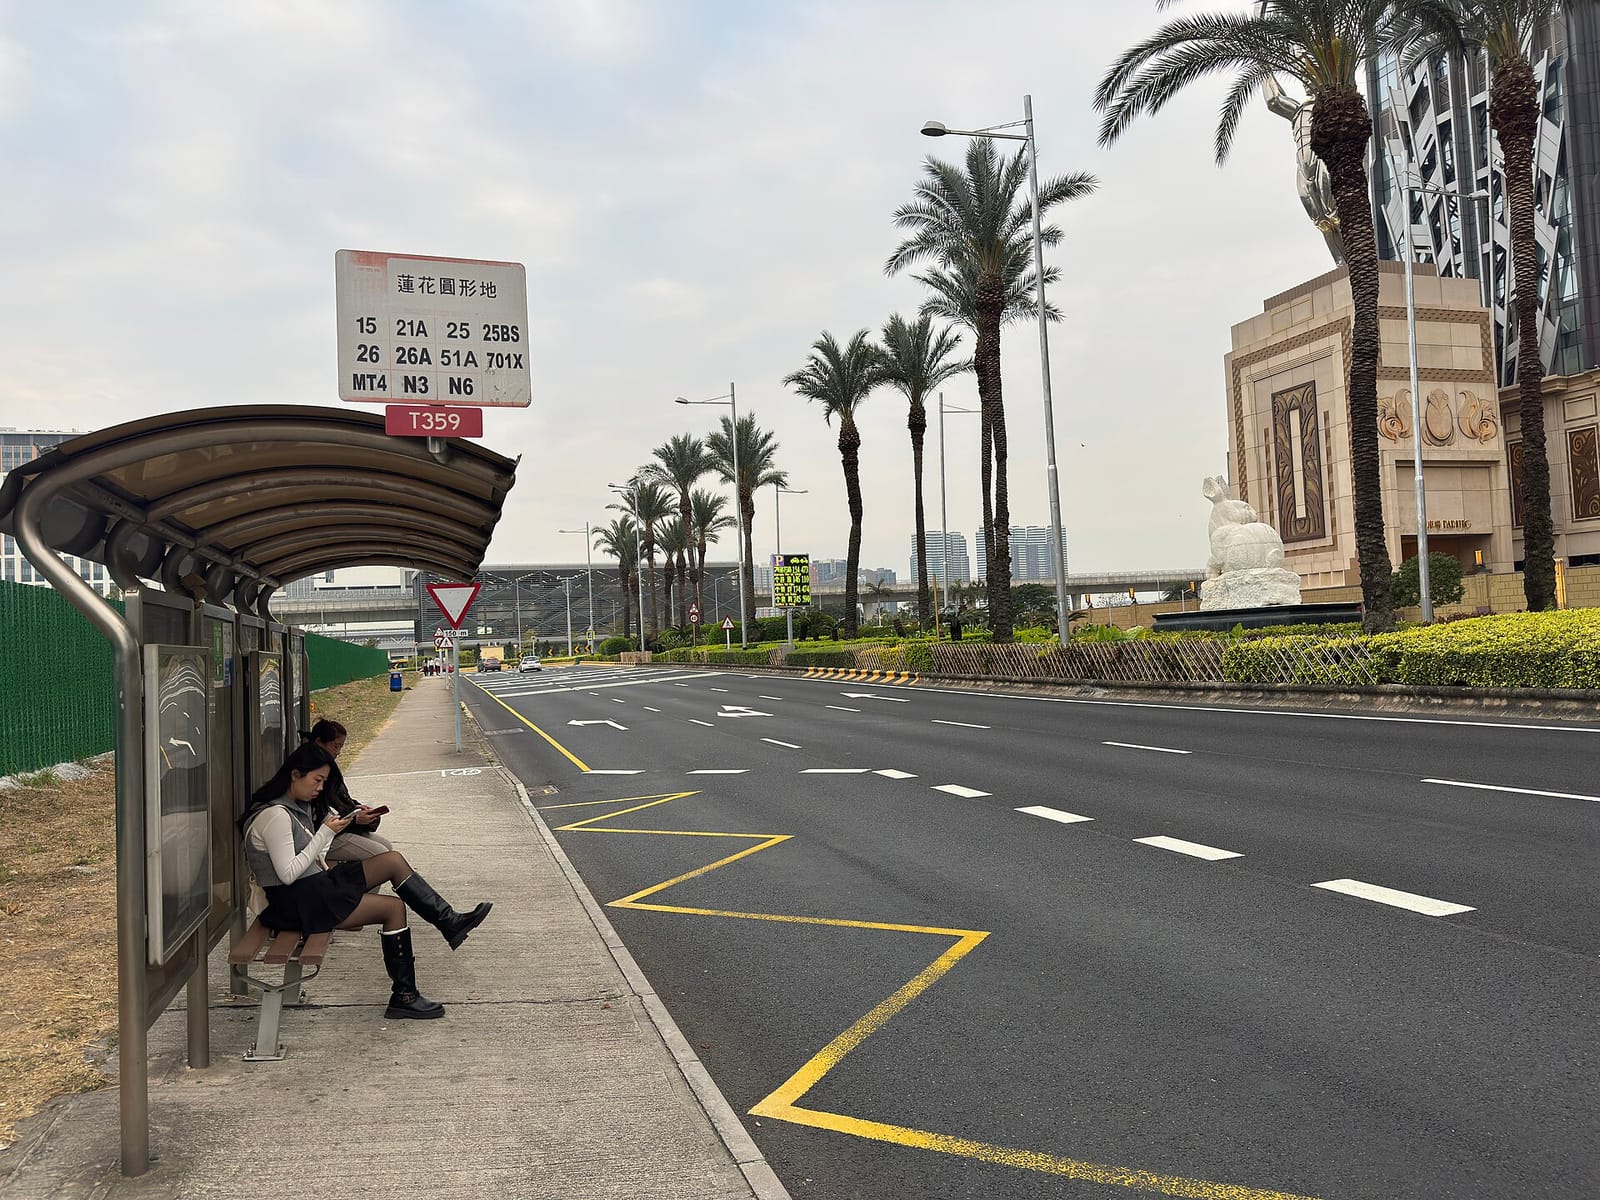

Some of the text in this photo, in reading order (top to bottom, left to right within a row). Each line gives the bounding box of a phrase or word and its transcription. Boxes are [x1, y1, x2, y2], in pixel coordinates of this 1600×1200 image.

[398, 274, 496, 298] 蓮花圓形地
[357, 317, 519, 342] 15 21A 25 25BS
[357, 344, 523, 369] 26 26A 51A 701X
[353, 374, 473, 395] MT4 N3 N6
[409, 412, 460, 430] T359
